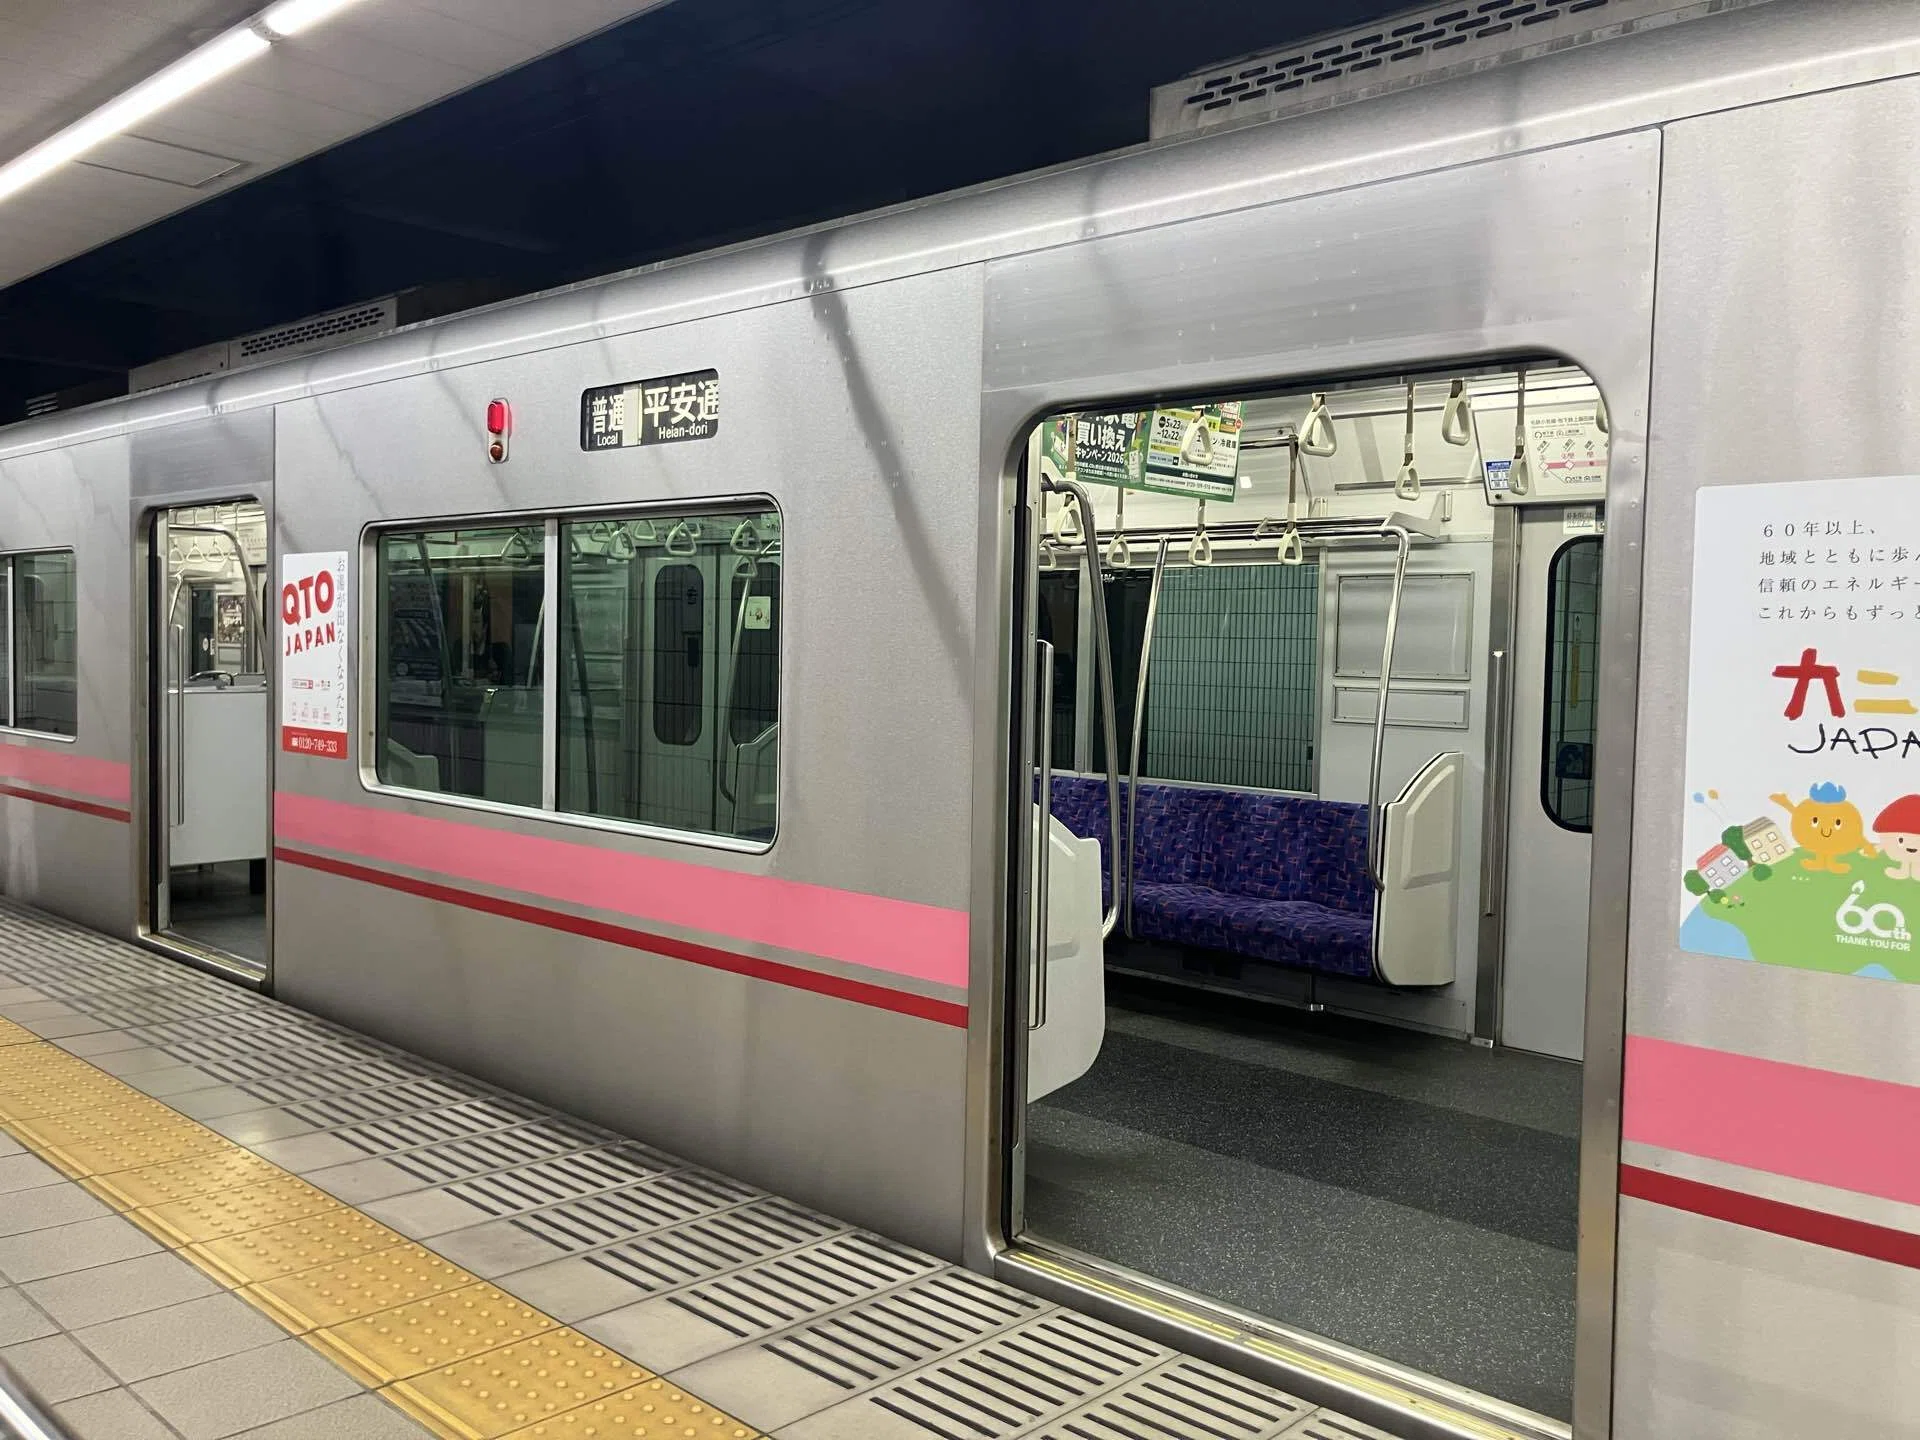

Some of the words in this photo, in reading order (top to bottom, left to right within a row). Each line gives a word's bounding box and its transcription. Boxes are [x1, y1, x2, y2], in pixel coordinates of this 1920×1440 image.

[592, 394, 624, 434] 普通
[644, 380, 719, 427] 平安通
[597, 432, 619, 447] Local
[658, 422, 708, 440] Heian-dori
[1076, 420, 1125, 452] 買い換え
[1075, 446, 1124, 464] キャンペーン2026
[282, 570, 335, 625] QTO
[285, 621, 336, 657] JAPAN
[1787, 723, 1920, 760] JAPA
[1835, 934, 1868, 947] THANK
[1869, 938, 1890, 949] YOU
